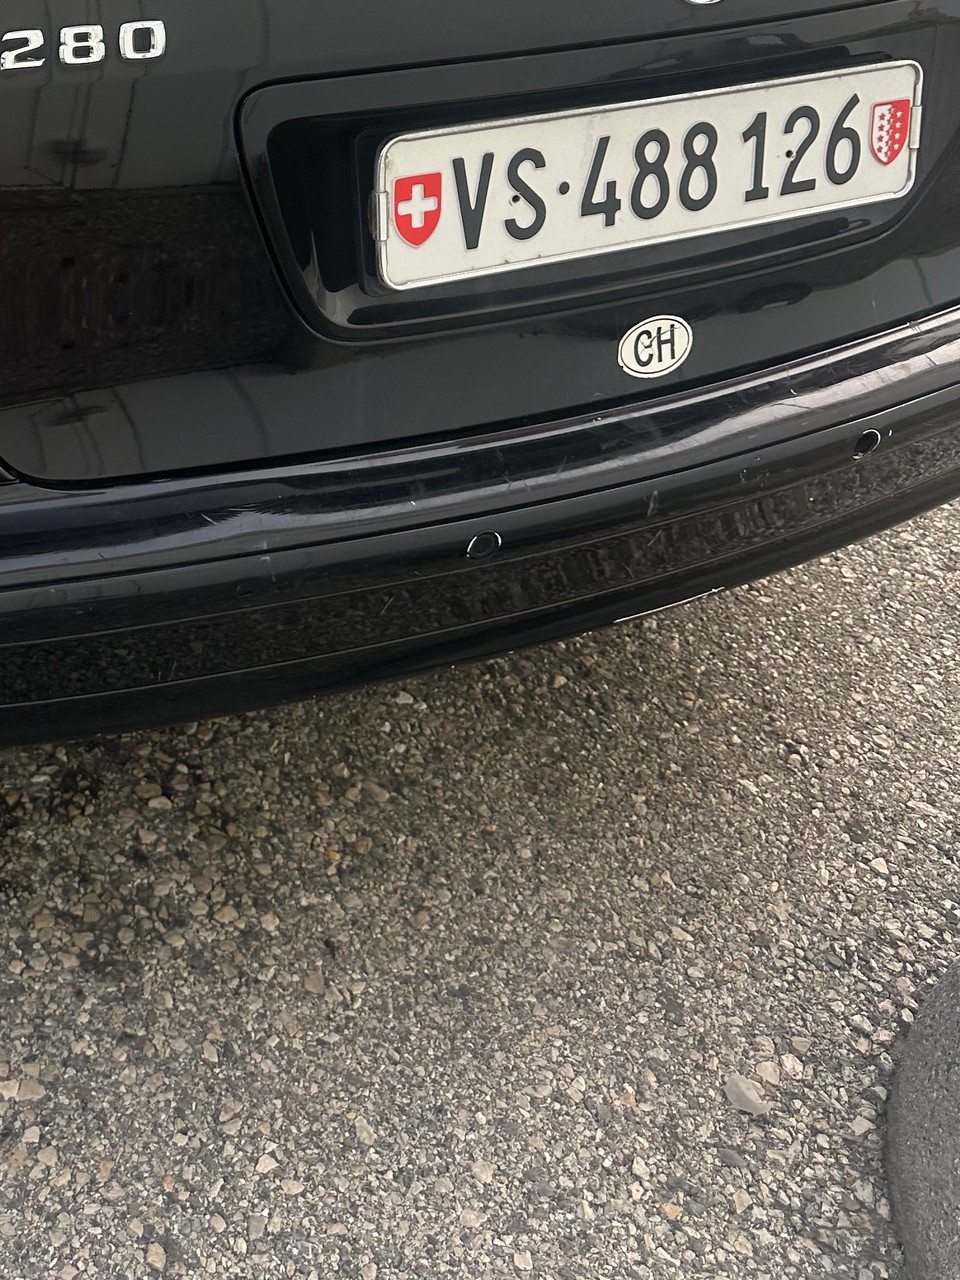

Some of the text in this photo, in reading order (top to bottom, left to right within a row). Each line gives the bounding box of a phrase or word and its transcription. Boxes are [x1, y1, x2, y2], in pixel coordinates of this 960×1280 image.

[0, 20, 167, 71] 280
[741, 92, 862, 203] 126
[633, 322, 676, 368] CH
